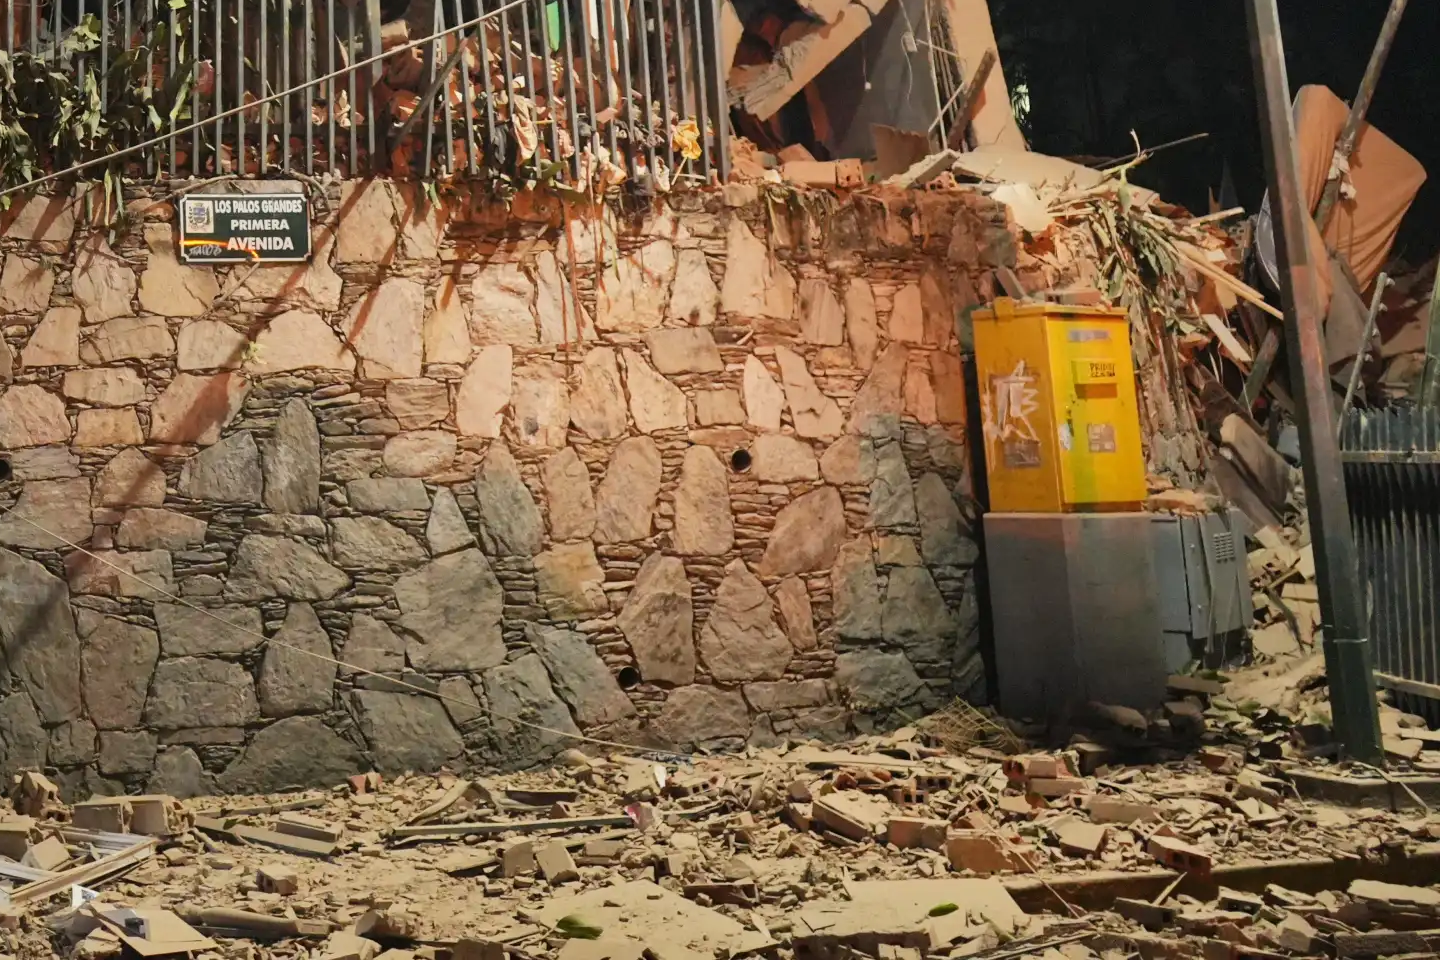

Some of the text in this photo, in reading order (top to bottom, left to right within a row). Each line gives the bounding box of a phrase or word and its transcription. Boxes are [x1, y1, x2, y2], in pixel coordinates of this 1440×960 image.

[214, 199, 303, 214] LOS PALOS GRANDES
[230, 219, 290, 231] PRIMERA
[227, 236, 294, 251] AVENIDA
